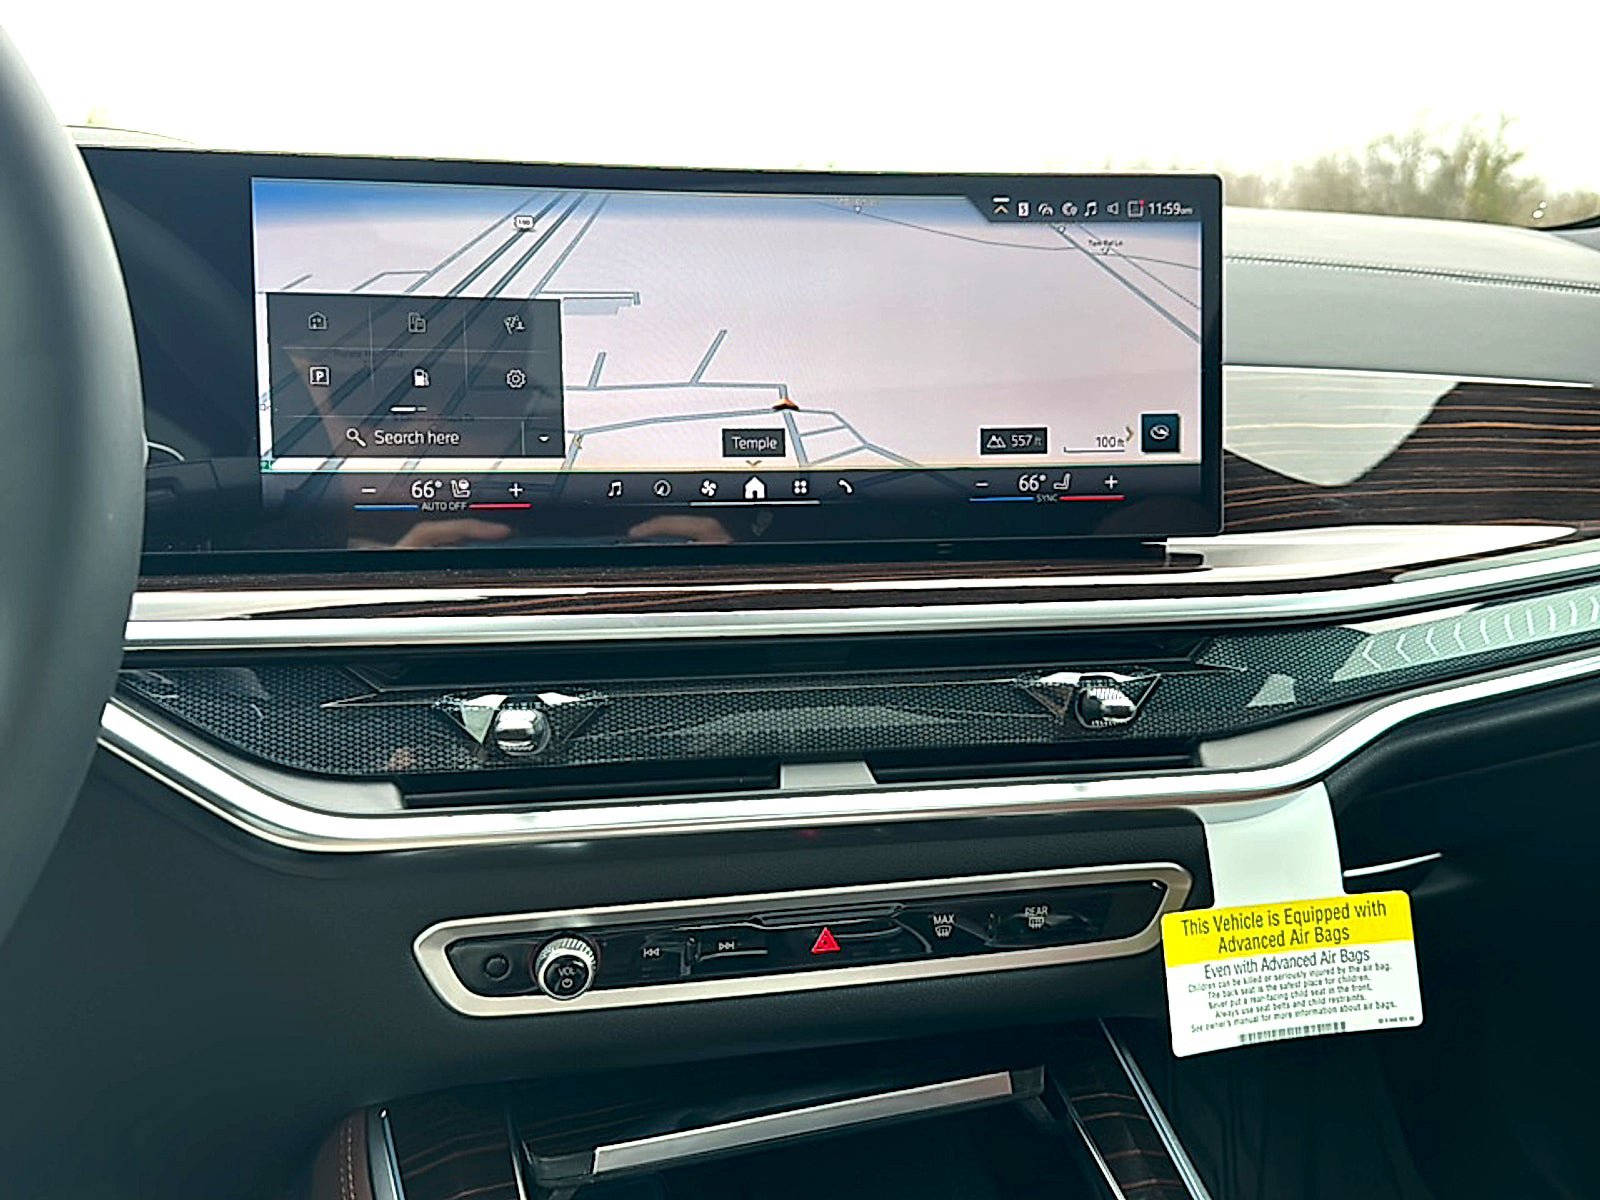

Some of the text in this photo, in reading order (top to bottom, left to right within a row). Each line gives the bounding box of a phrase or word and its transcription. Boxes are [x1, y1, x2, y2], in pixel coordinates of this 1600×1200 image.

[375, 430, 460, 445] Search here
[1012, 435, 1033, 447] 557
[732, 437, 778, 451] Temple
[1037, 494, 1058, 503] SYNC
[422, 502, 468, 512] AUTO OFF
[1025, 906, 1048, 918] REAR
[1181, 900, 1387, 936] This Vehicle is Equipped with
[933, 914, 955, 925] MAX
[1219, 926, 1350, 953] Advanced Air Bags
[1204, 949, 1370, 979] Even with Advanced Air Bags
[1349, 965, 1360, 973] the
[1363, 964, 1372, 972] air
[1266, 984, 1277, 992] the
[1325, 977, 1335, 985] for
[1293, 1000, 1306, 1008] and
[1340, 1004, 1360, 1013] about
